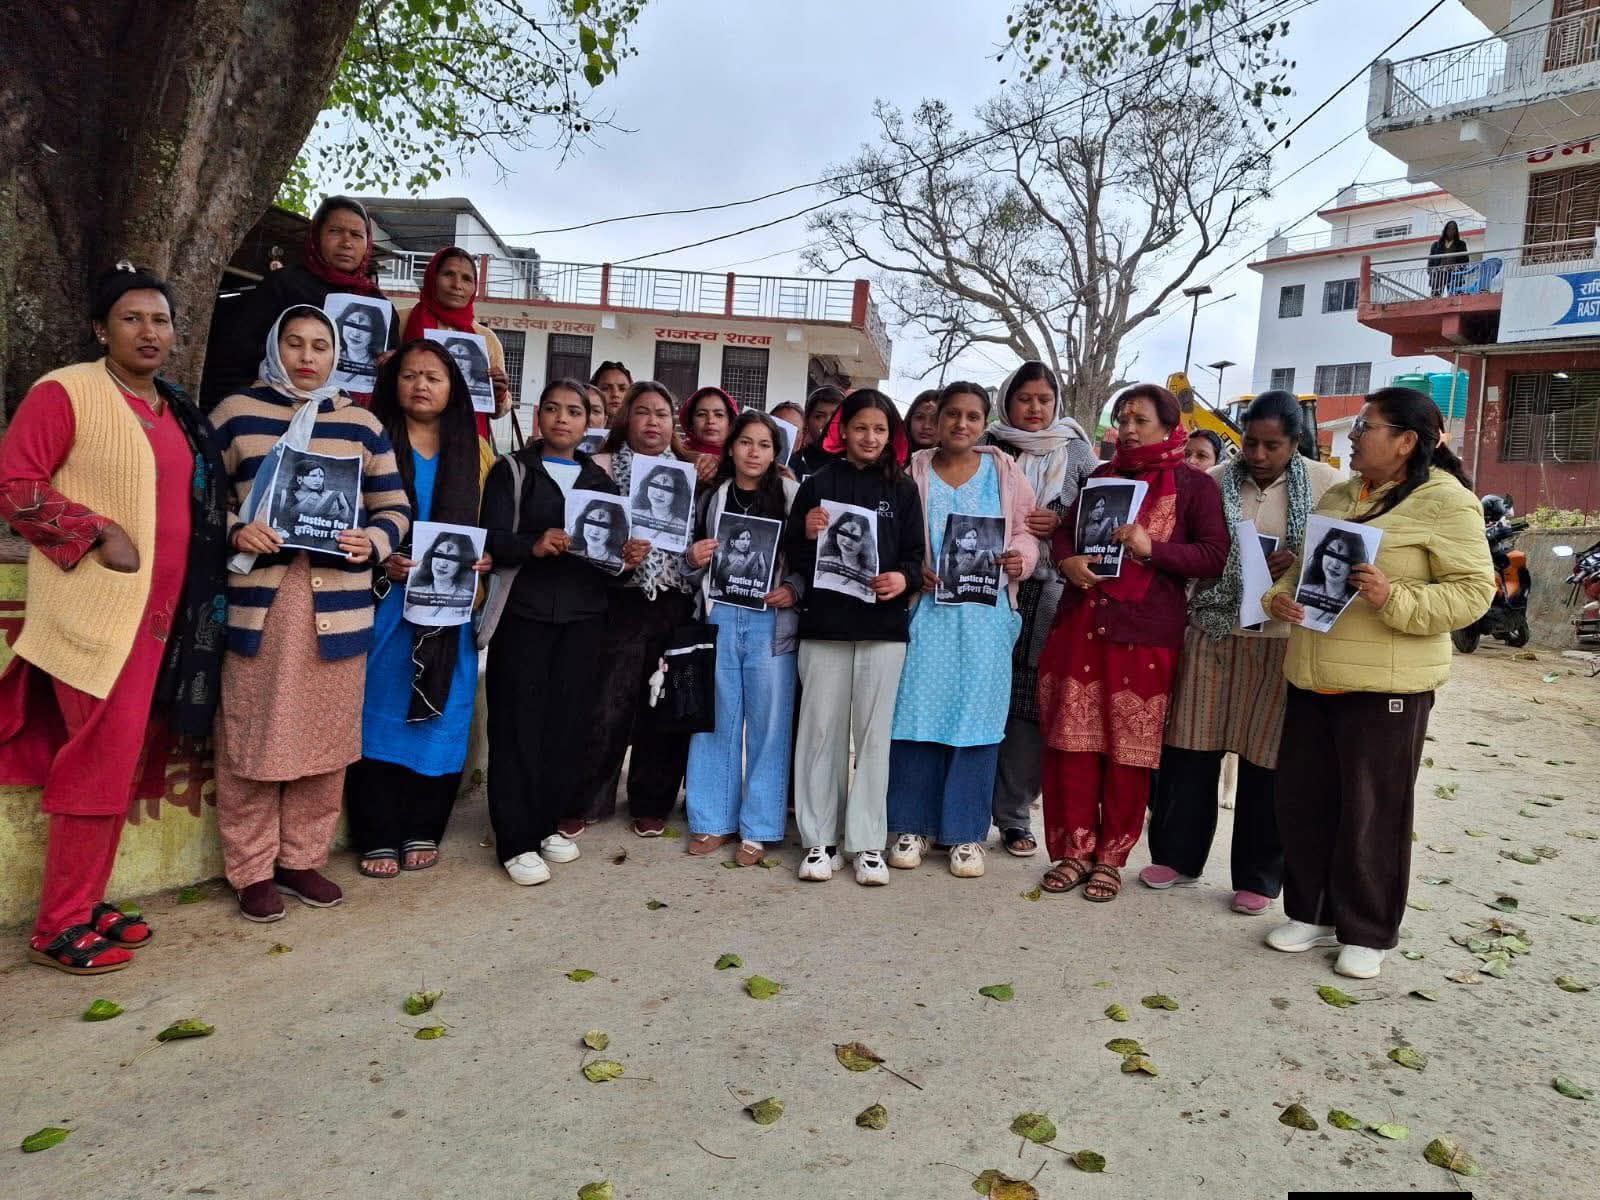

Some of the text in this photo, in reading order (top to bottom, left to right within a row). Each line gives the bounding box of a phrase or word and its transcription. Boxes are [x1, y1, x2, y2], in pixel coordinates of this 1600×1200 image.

[552, 320, 596, 333] शाखा
[655, 328, 773, 345] राजस्व शाखा
[298, 513, 349, 530] Justice for
[728, 574, 765, 588] Justice for
[959, 574, 996, 585] Justice for
